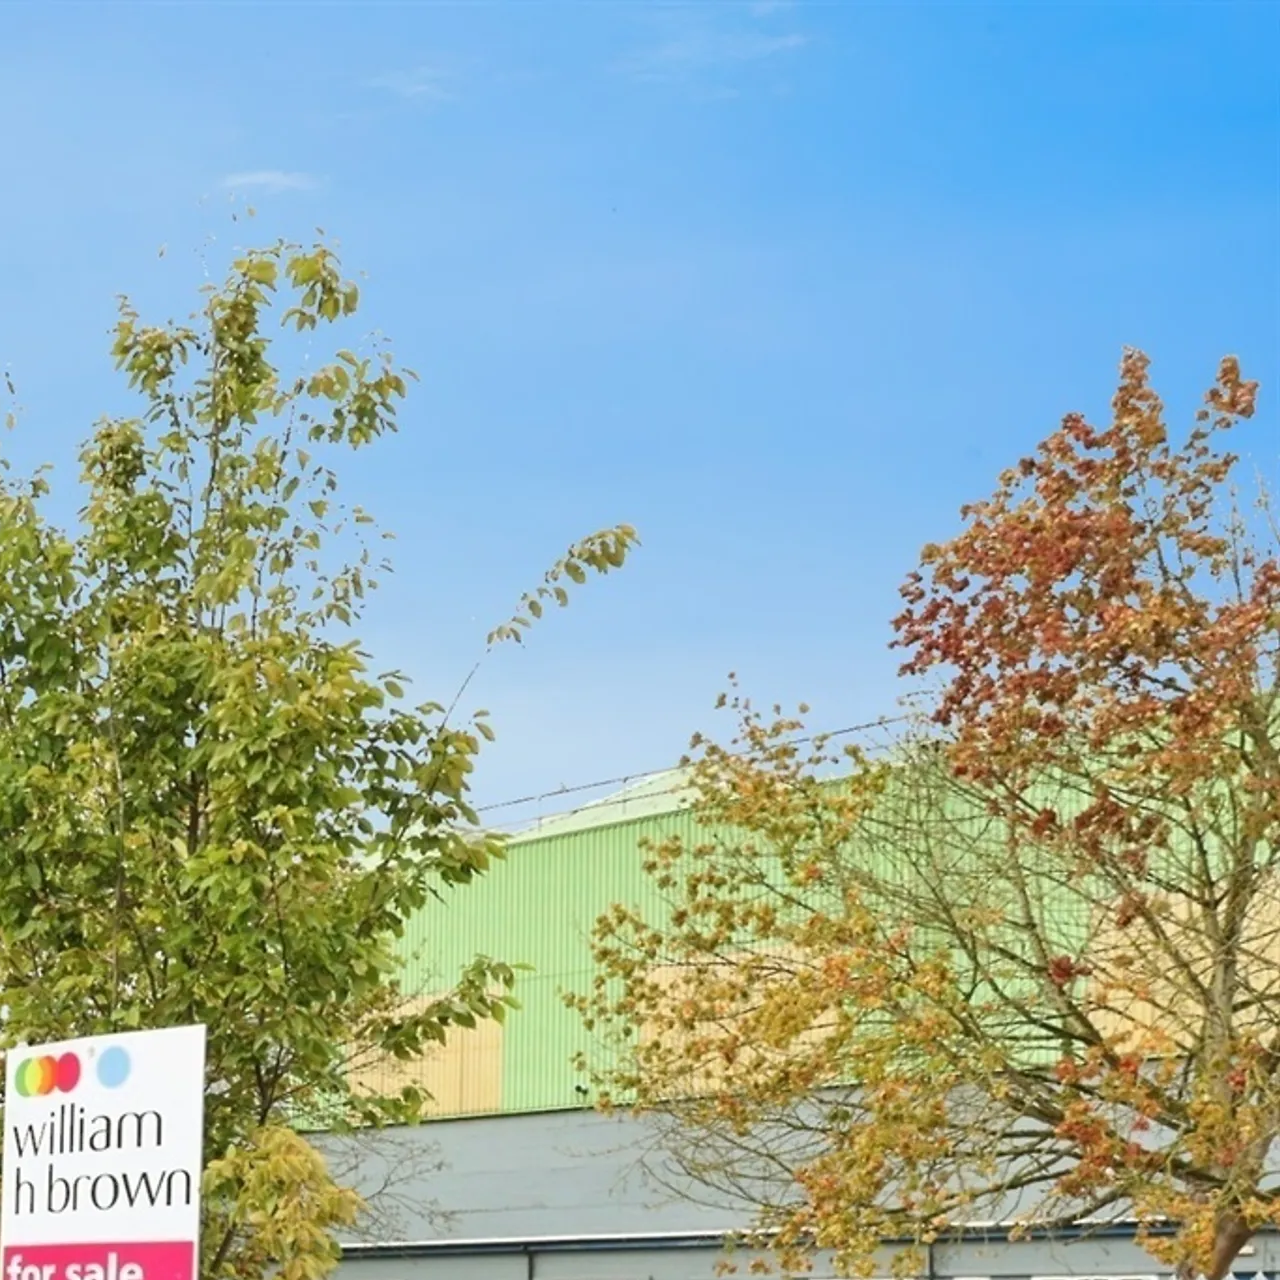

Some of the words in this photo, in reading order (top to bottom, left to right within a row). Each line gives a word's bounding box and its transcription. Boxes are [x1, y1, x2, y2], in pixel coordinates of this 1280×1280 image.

[13, 1102, 162, 1158] william
[14, 1166, 35, 1215] h
[47, 1163, 191, 1214] brown
